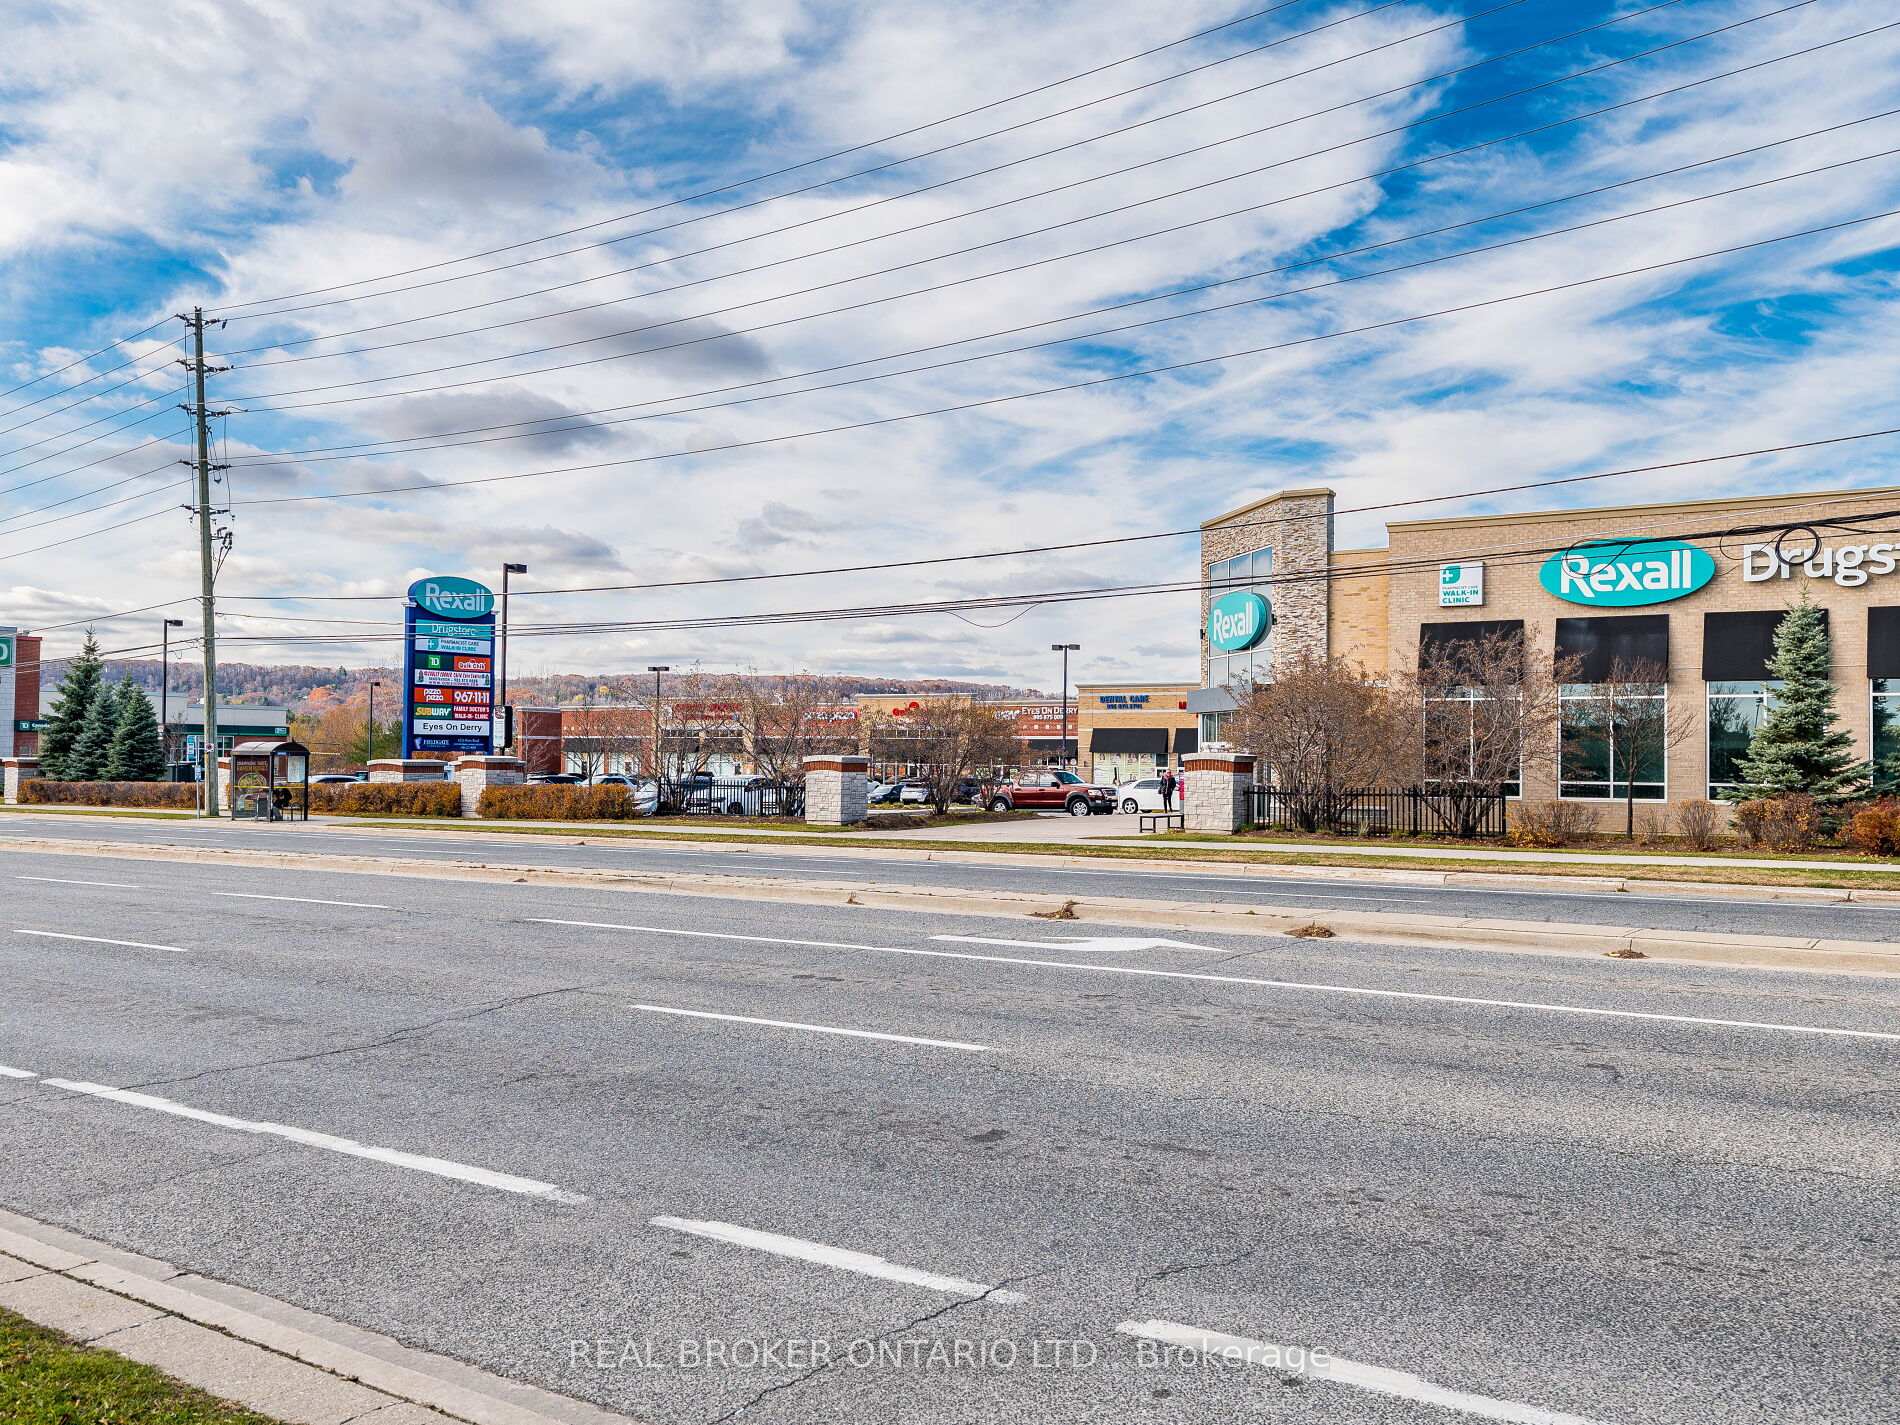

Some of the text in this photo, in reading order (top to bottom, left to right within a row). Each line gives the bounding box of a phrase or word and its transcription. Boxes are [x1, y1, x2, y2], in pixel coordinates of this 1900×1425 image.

[1560, 550, 1692, 598] Rexall
[1743, 543, 1900, 587] Drugs
[426, 583, 485, 611] Rexall
[1213, 601, 1253, 643] Rexall
[431, 658, 440, 666] TD
[416, 708, 451, 716] SUBWAY
[423, 723, 482, 732] Eyes On Derry
